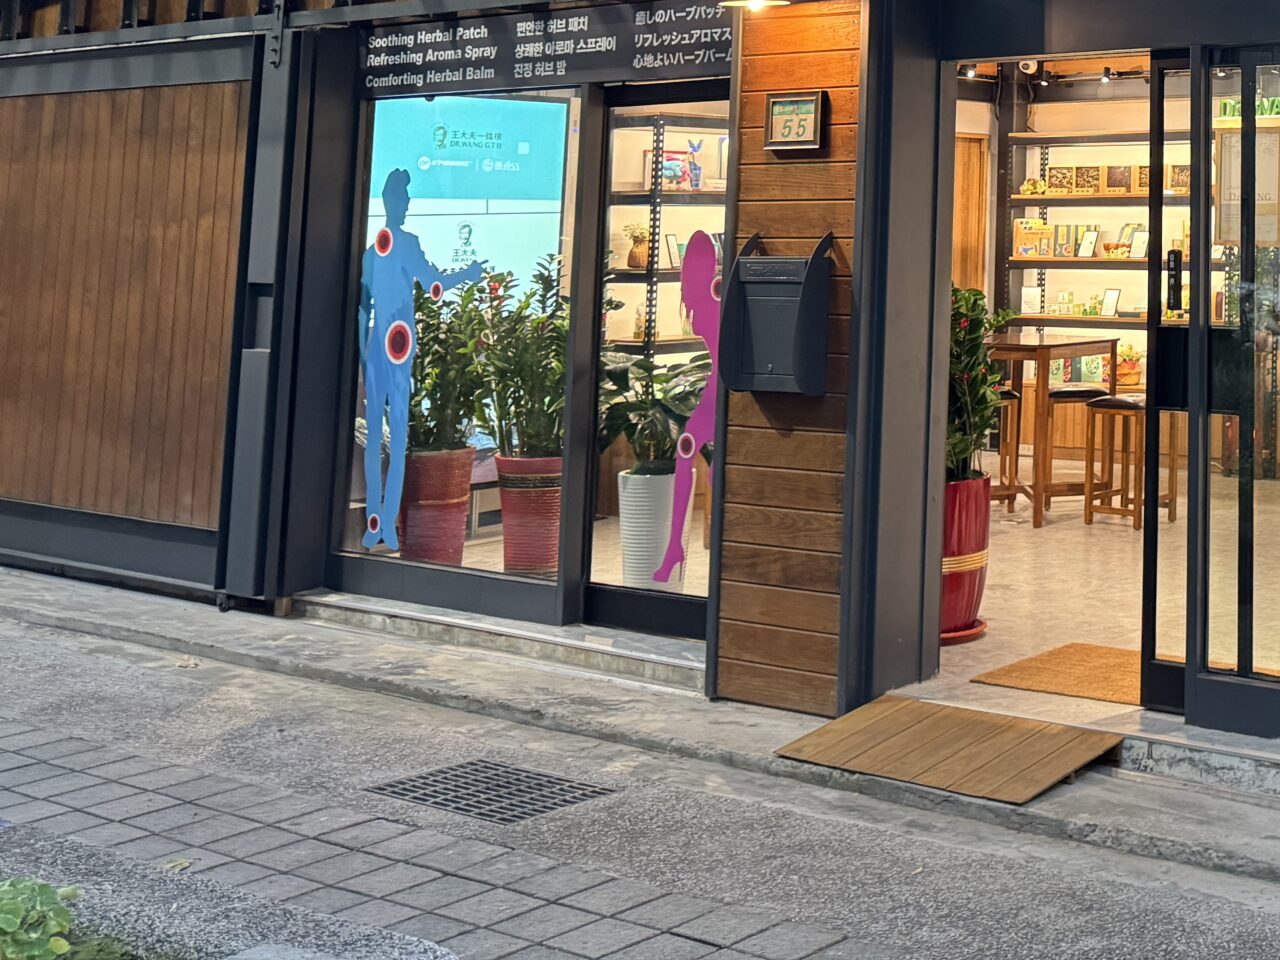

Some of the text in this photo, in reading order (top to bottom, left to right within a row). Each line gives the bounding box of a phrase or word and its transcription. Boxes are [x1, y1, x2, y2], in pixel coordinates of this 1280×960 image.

[367, 24, 488, 49] Soothing Herbal Patch
[516, 15, 589, 37] 편안한 허브 패치
[366, 44, 498, 67] Refreshing Aroma Spray
[514, 35, 617, 59] 상쾌한 아로마 스프레이
[365, 65, 495, 88] Comforting Herbal Balm
[513, 59, 567, 79] 진정 허브 밤
[781, 117, 808, 138] 55
